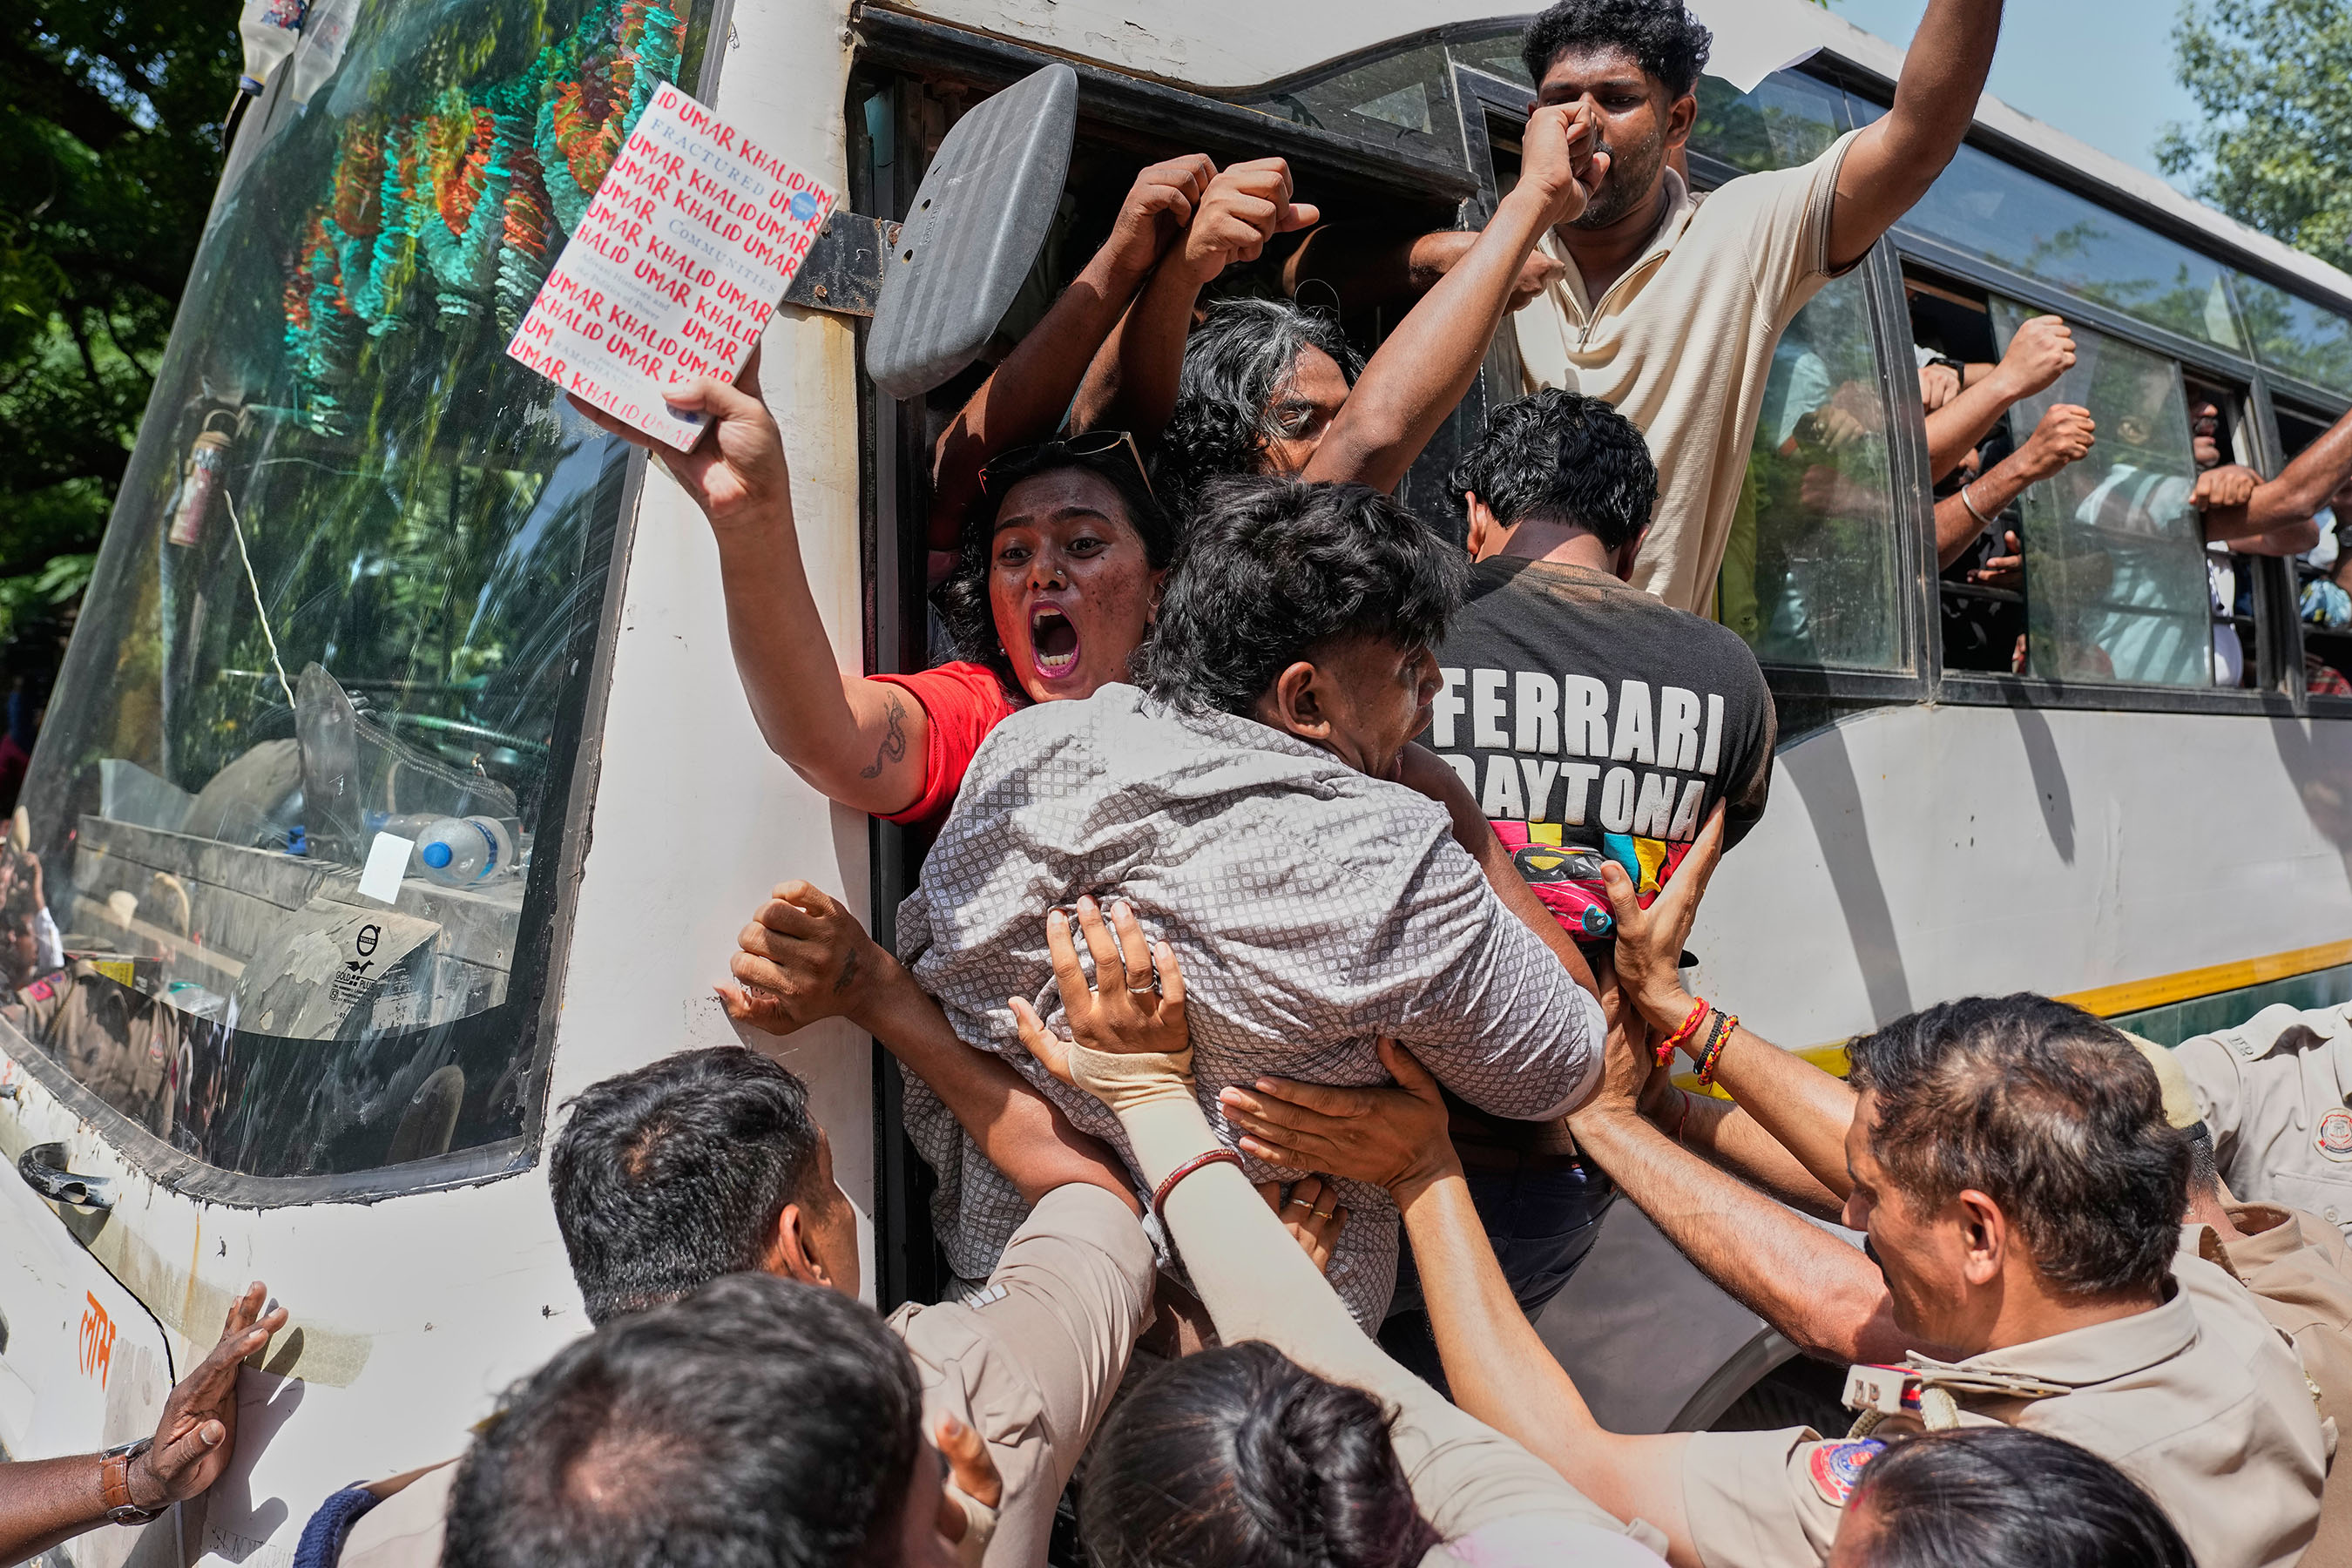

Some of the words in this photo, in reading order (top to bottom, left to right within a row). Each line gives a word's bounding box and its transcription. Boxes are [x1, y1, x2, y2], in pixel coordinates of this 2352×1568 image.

[650, 118, 765, 197] FRACTURED
[653, 91, 677, 109] ID
[679, 102, 735, 152] UMAR
[739, 139, 805, 191] KHALID
[598, 176, 656, 225] UMAR
[612, 153, 669, 201] UMAR
[673, 189, 742, 241] KHALID
[743, 233, 799, 280] UMAR
[628, 132, 685, 181] UMAR
[688, 168, 757, 220] KHALID
[756, 212, 810, 258] UMAR
[769, 189, 823, 235] UR
[587, 200, 643, 247] UMAR
[646, 235, 716, 287] KHALID
[716, 280, 772, 326] UMAR
[634, 260, 691, 307] UMAR
[694, 295, 761, 347] KHALID
[653, 298, 671, 312] and
[524, 315, 554, 346] UM
[534, 290, 604, 341] KHALID
[606, 335, 664, 382] UMAR
[547, 269, 605, 317] UMAR
[608, 304, 678, 355] KHALID
[681, 318, 739, 366] UMAR
[510, 337, 566, 385] UMAR
[571, 372, 639, 419] KHALID
[1433, 667, 1724, 775] FERRARI
[335, 970, 351, 982] GOLD
[359, 979, 375, 990] PLUS
